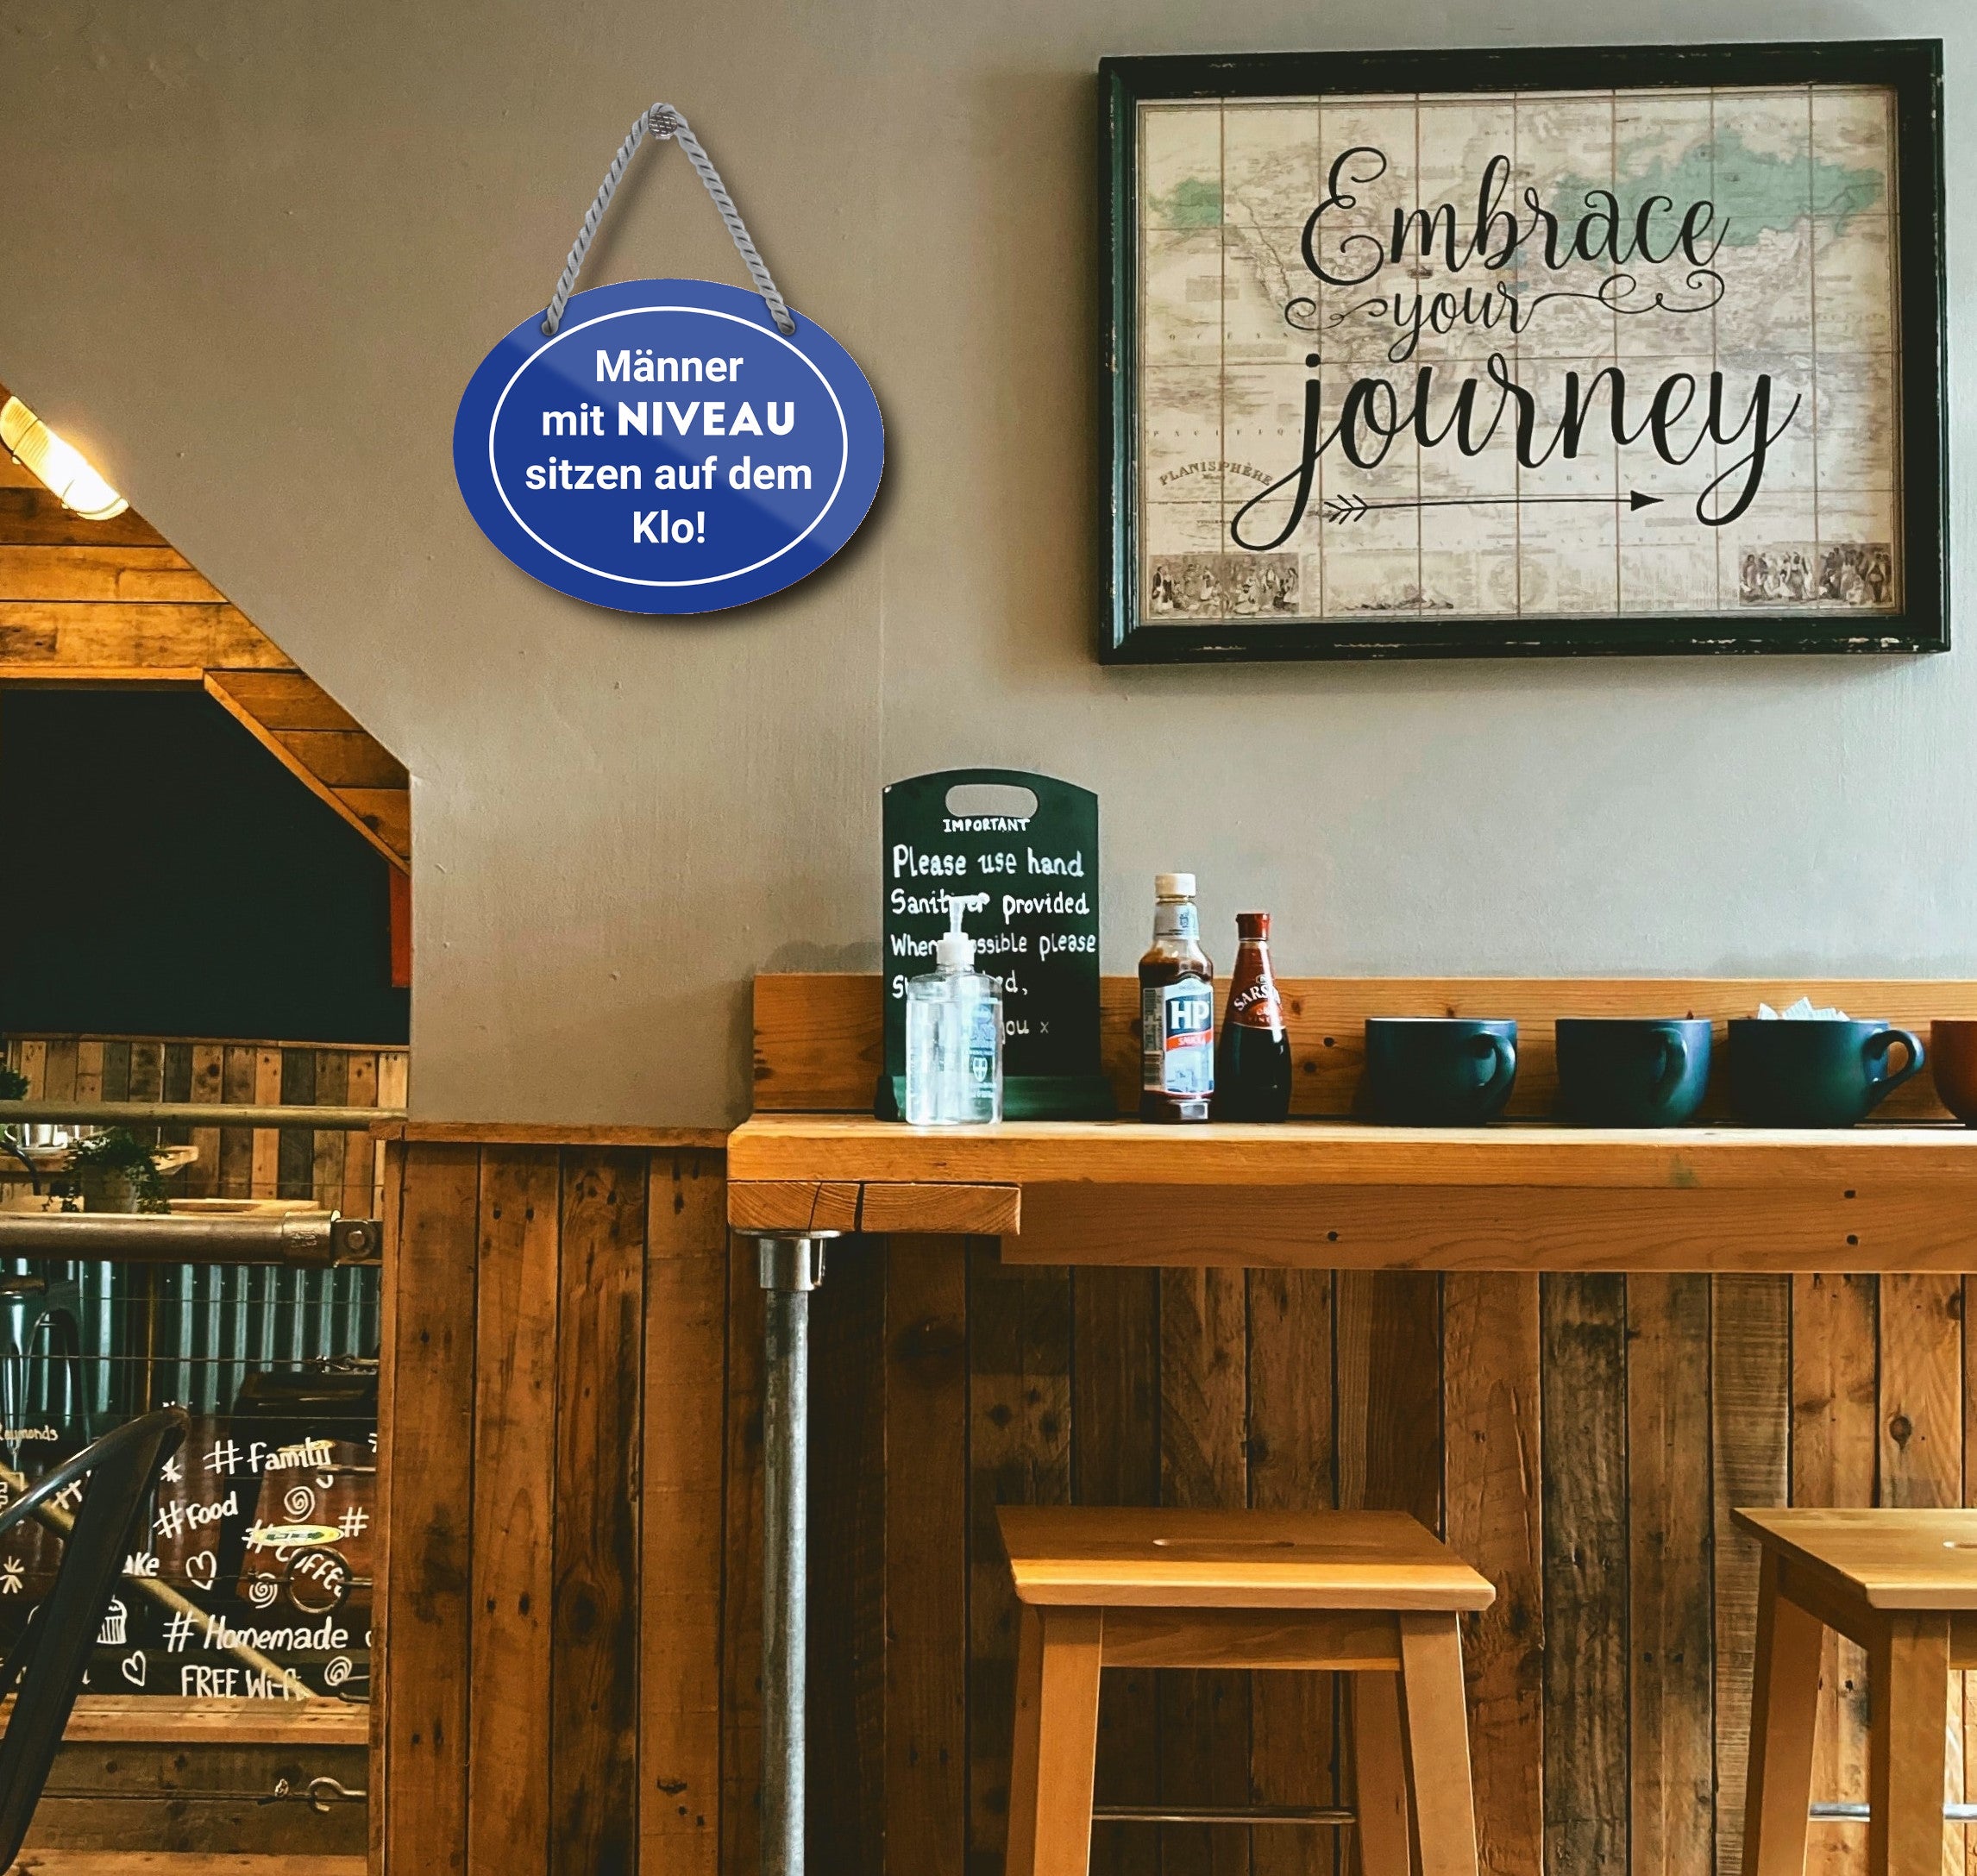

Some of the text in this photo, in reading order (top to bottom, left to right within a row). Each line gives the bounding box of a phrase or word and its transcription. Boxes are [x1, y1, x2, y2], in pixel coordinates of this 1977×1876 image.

[1300, 146, 1729, 286] Embrace
[595, 349, 744, 382] Männer
[543, 401, 794, 436] mit NIVEAU
[1230, 353, 1802, 551] journey
[524, 455, 813, 490] sitzen auf dem
[632, 509, 706, 544] Klo!
[943, 818, 1031, 833] IMPORTANT
[893, 844, 1085, 878] Please use hand
[1002, 891, 1090, 925] provided
[1039, 932, 1096, 962] please
[1170, 1001, 1210, 1030] HP
[181, 1665, 239, 1698] FREE
